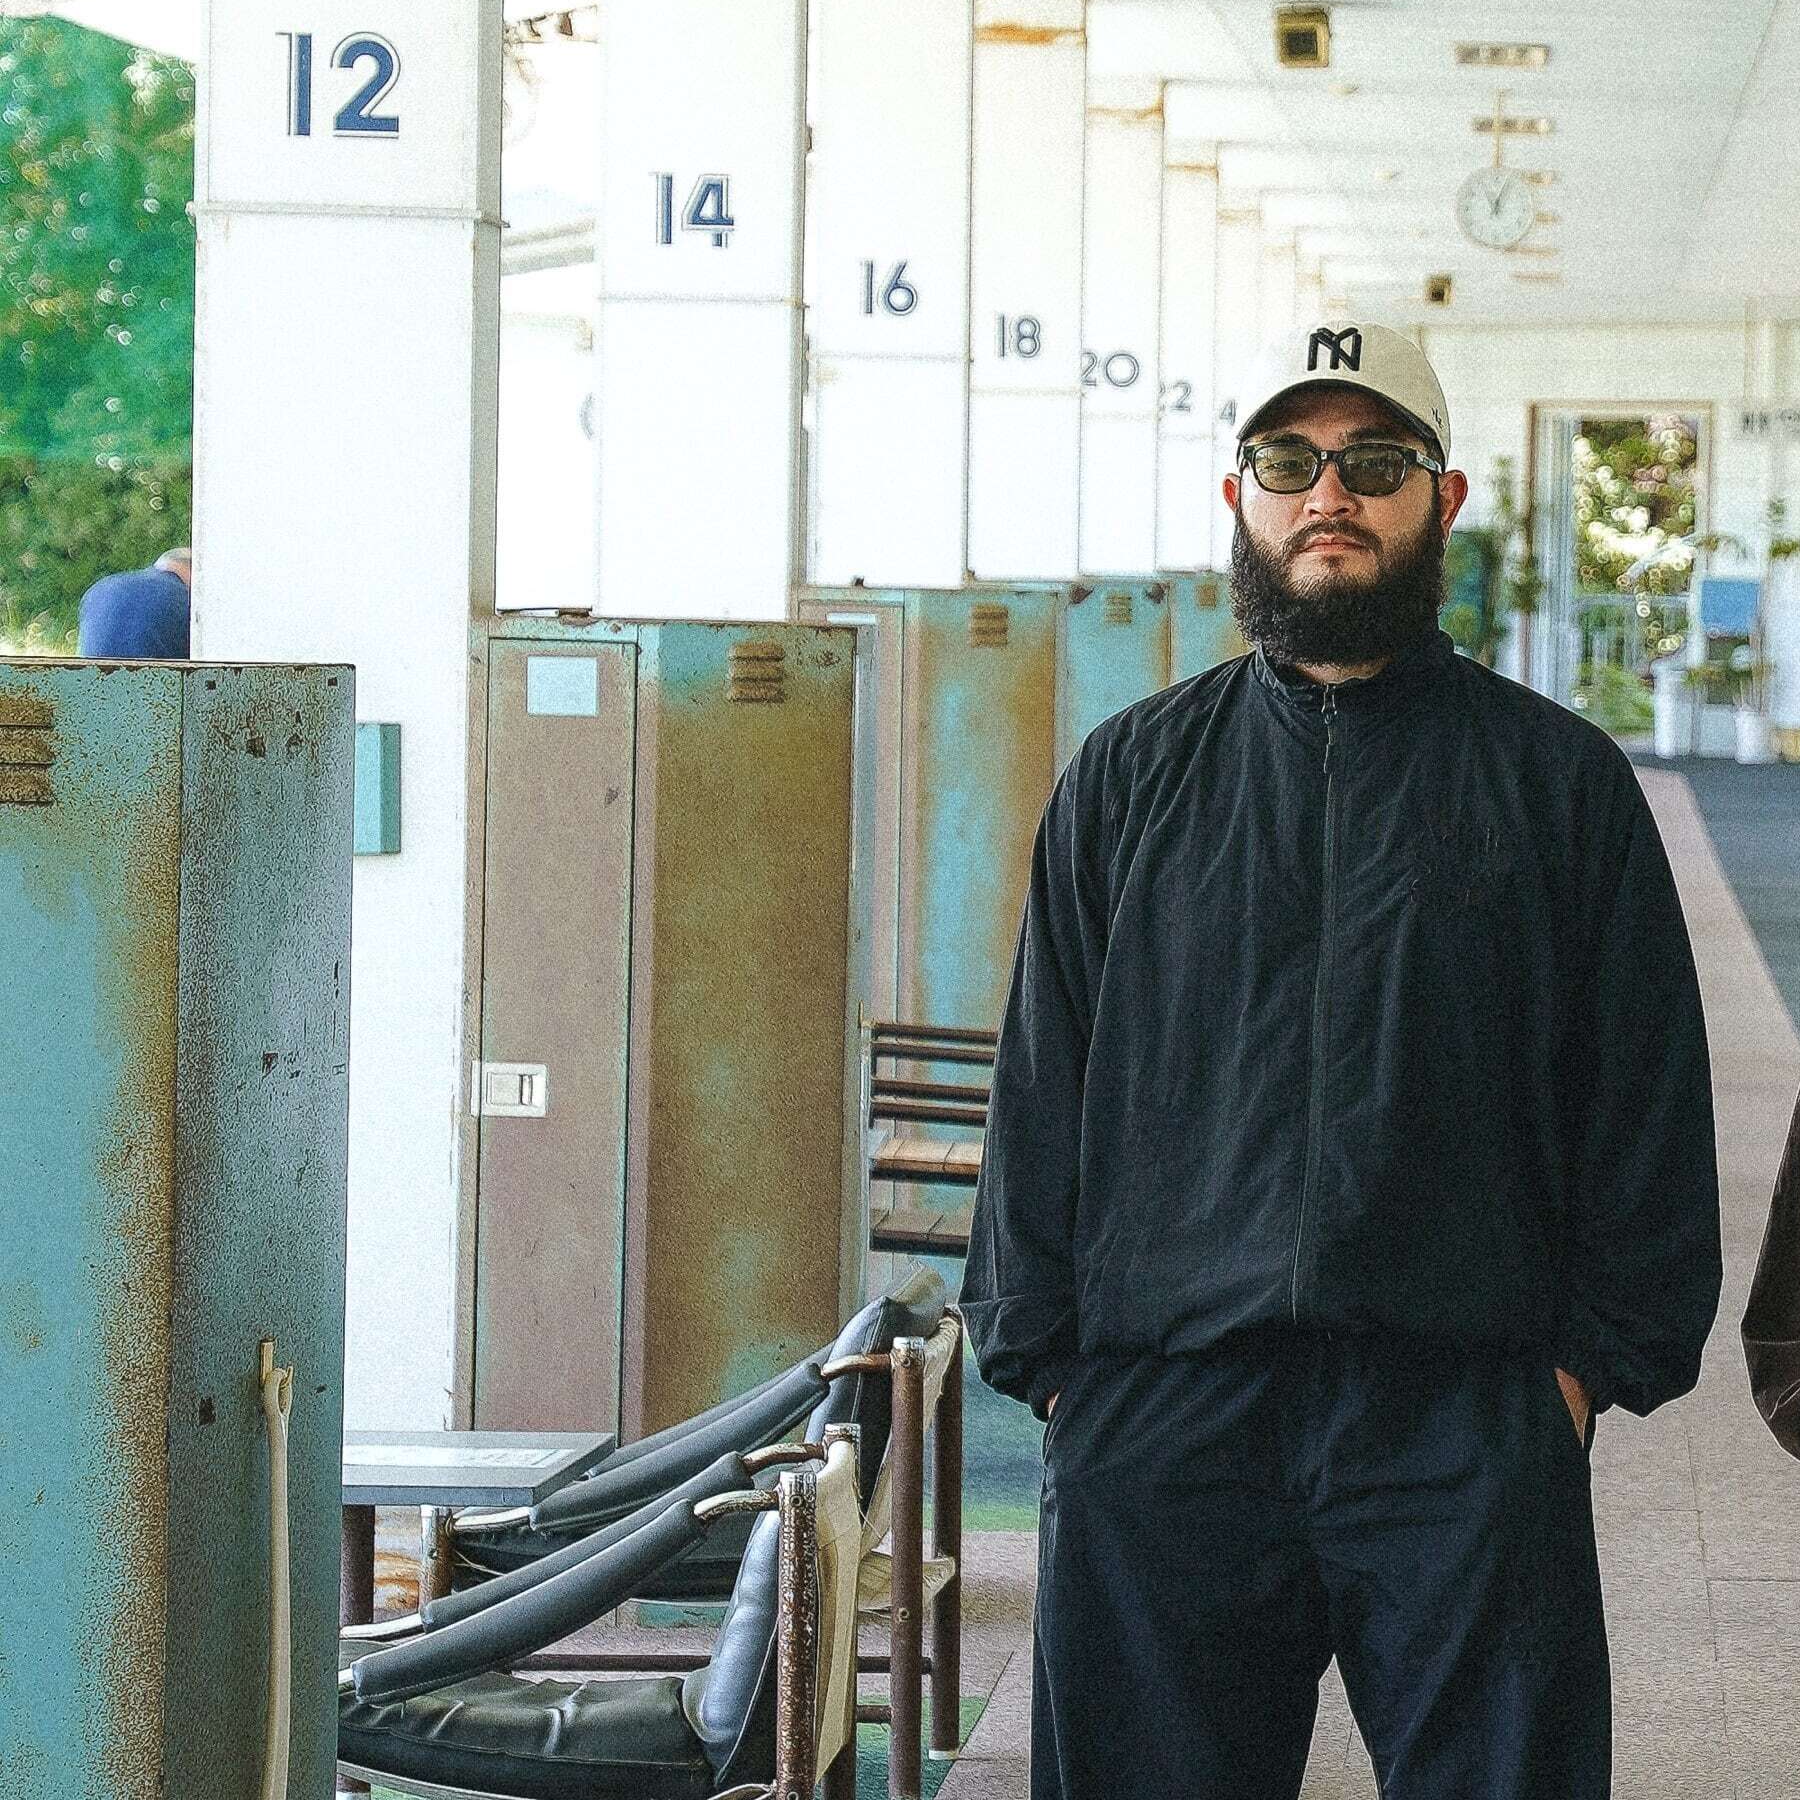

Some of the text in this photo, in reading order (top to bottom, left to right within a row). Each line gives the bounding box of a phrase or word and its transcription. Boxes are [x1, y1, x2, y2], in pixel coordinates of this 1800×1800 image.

[275, 31, 401, 140] 12
[648, 171, 735, 249] 14
[856, 259, 918, 316] 16
[996, 313, 1041, 358] 18
[1081, 351, 1140, 388] 20
[1159, 381, 1192, 413] 2
